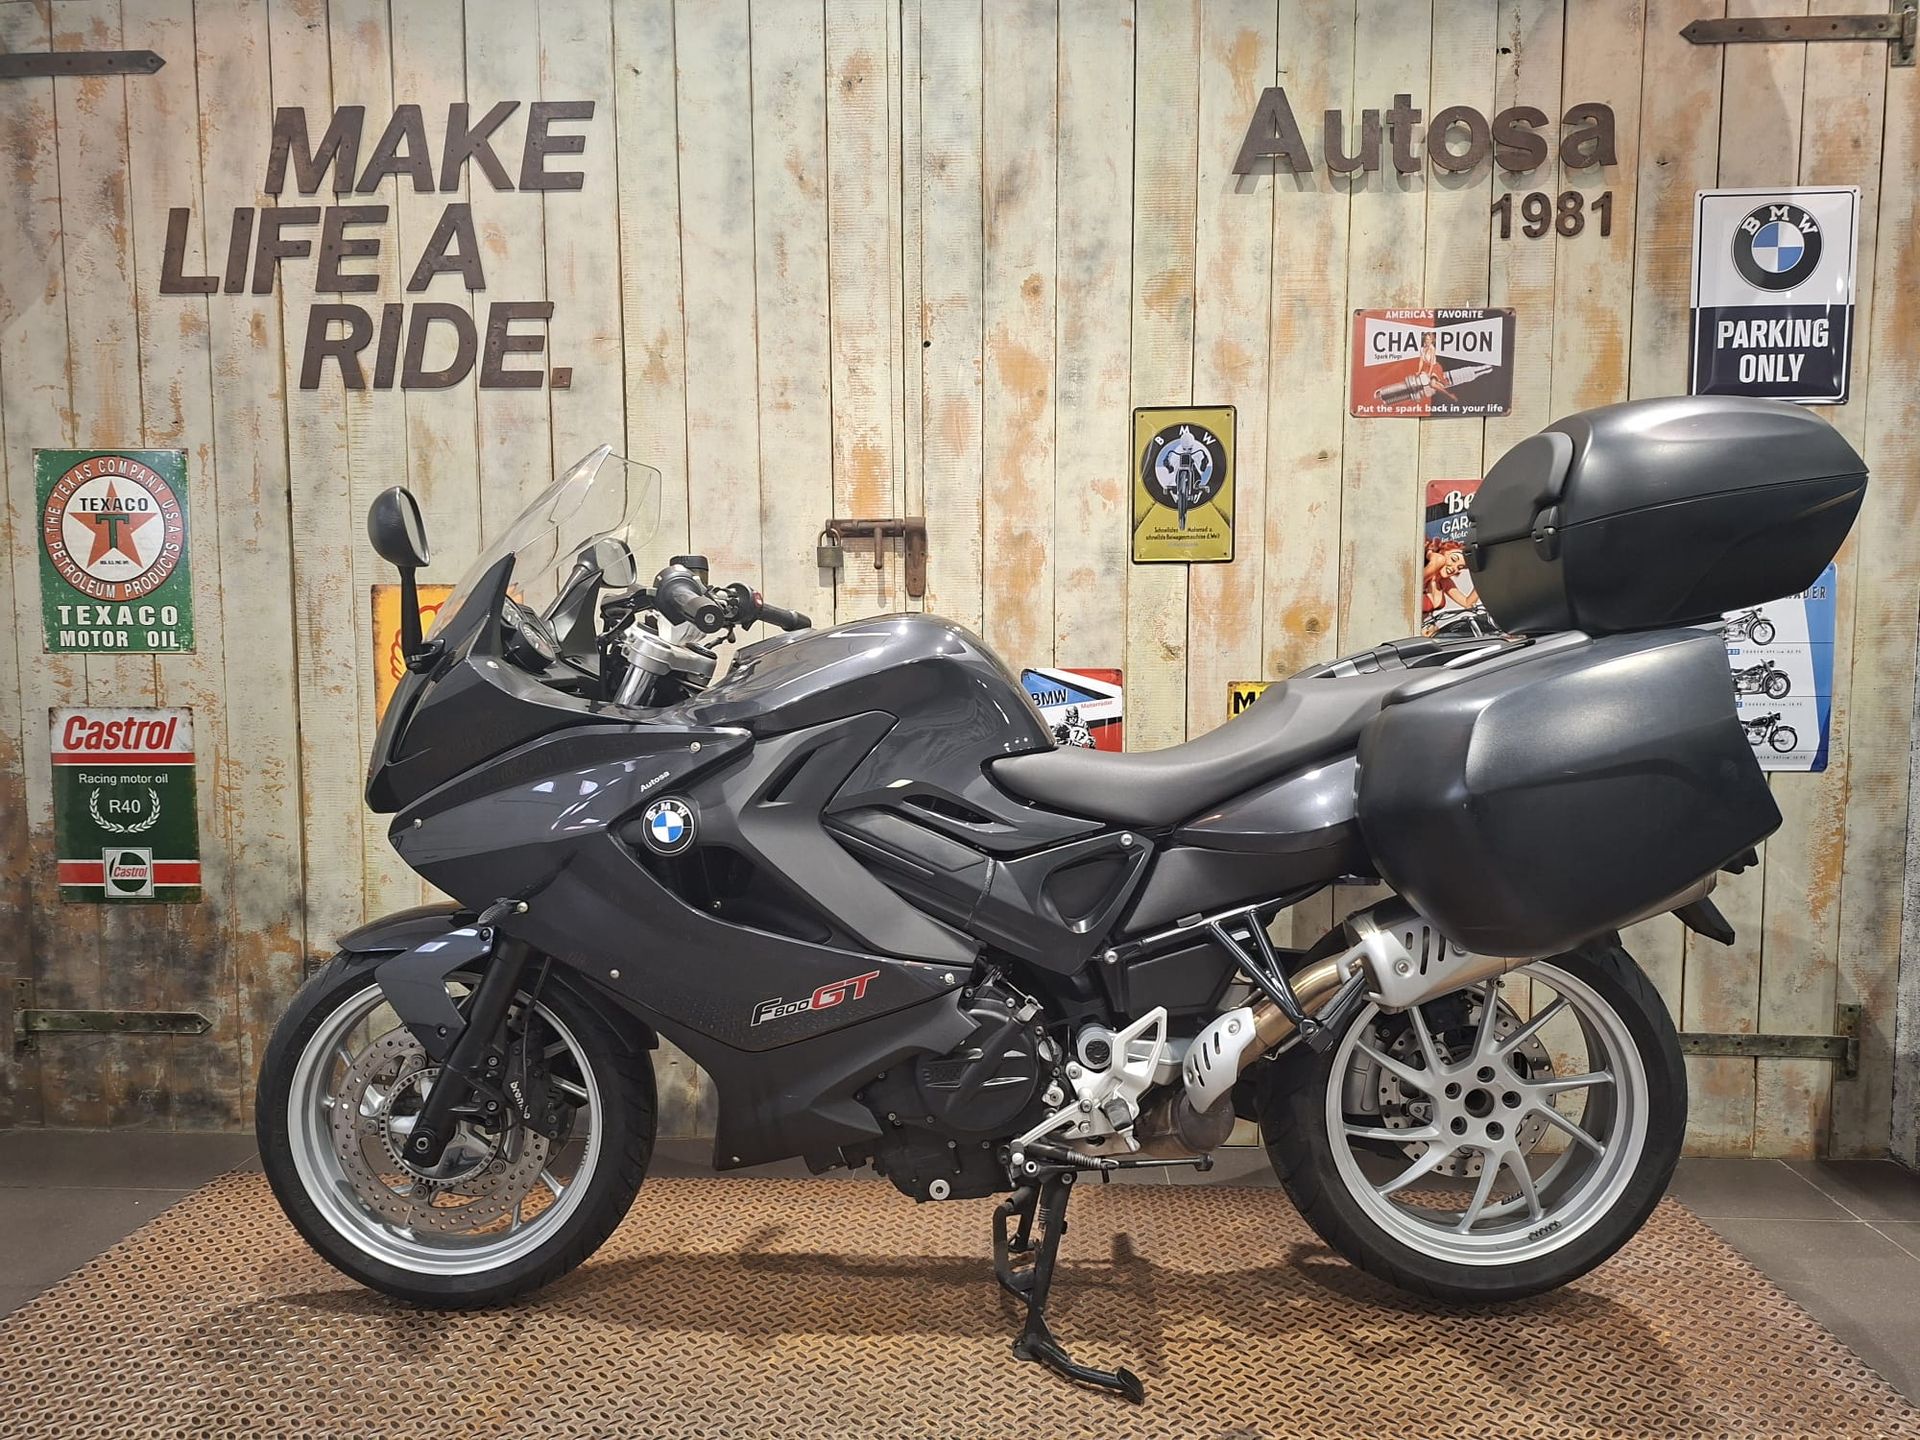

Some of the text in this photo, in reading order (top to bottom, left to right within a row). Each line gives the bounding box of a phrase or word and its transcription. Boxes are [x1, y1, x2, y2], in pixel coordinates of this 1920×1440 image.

[1232, 86, 1619, 175] Autosa
[264, 101, 596, 195] MAKE
[1490, 191, 1613, 239] 1981
[1741, 205, 1819, 236] BMW
[159, 203, 487, 295] LIFE A
[1385, 309, 1484, 319] AMERICA'S FAVORITE
[1716, 318, 1830, 350] PARKING
[299, 302, 573, 391] RIDE.
[1738, 353, 1805, 384] ONLY
[1357, 404, 1503, 414] Put the spark back in your life
[46, 507, 62, 534] THE
[54, 464, 92, 501] TEXAS
[98, 459, 167, 494] COMPANY
[79, 498, 149, 511] TEXACO
[49, 541, 180, 599] PETROLEUM PRODUCTS
[57, 605, 178, 625] TEXACO
[60, 630, 179, 647] MOTOR OIL
[1032, 688, 1067, 706] BMW
[1234, 691, 1262, 714] M
[62, 715, 178, 750] Castrol
[78, 773, 169, 785] Racing motor oil
[640, 771, 670, 793] Autosa
[109, 799, 141, 813] R40
[645, 801, 690, 822] BMW
[113, 867, 148, 877] Castrol
